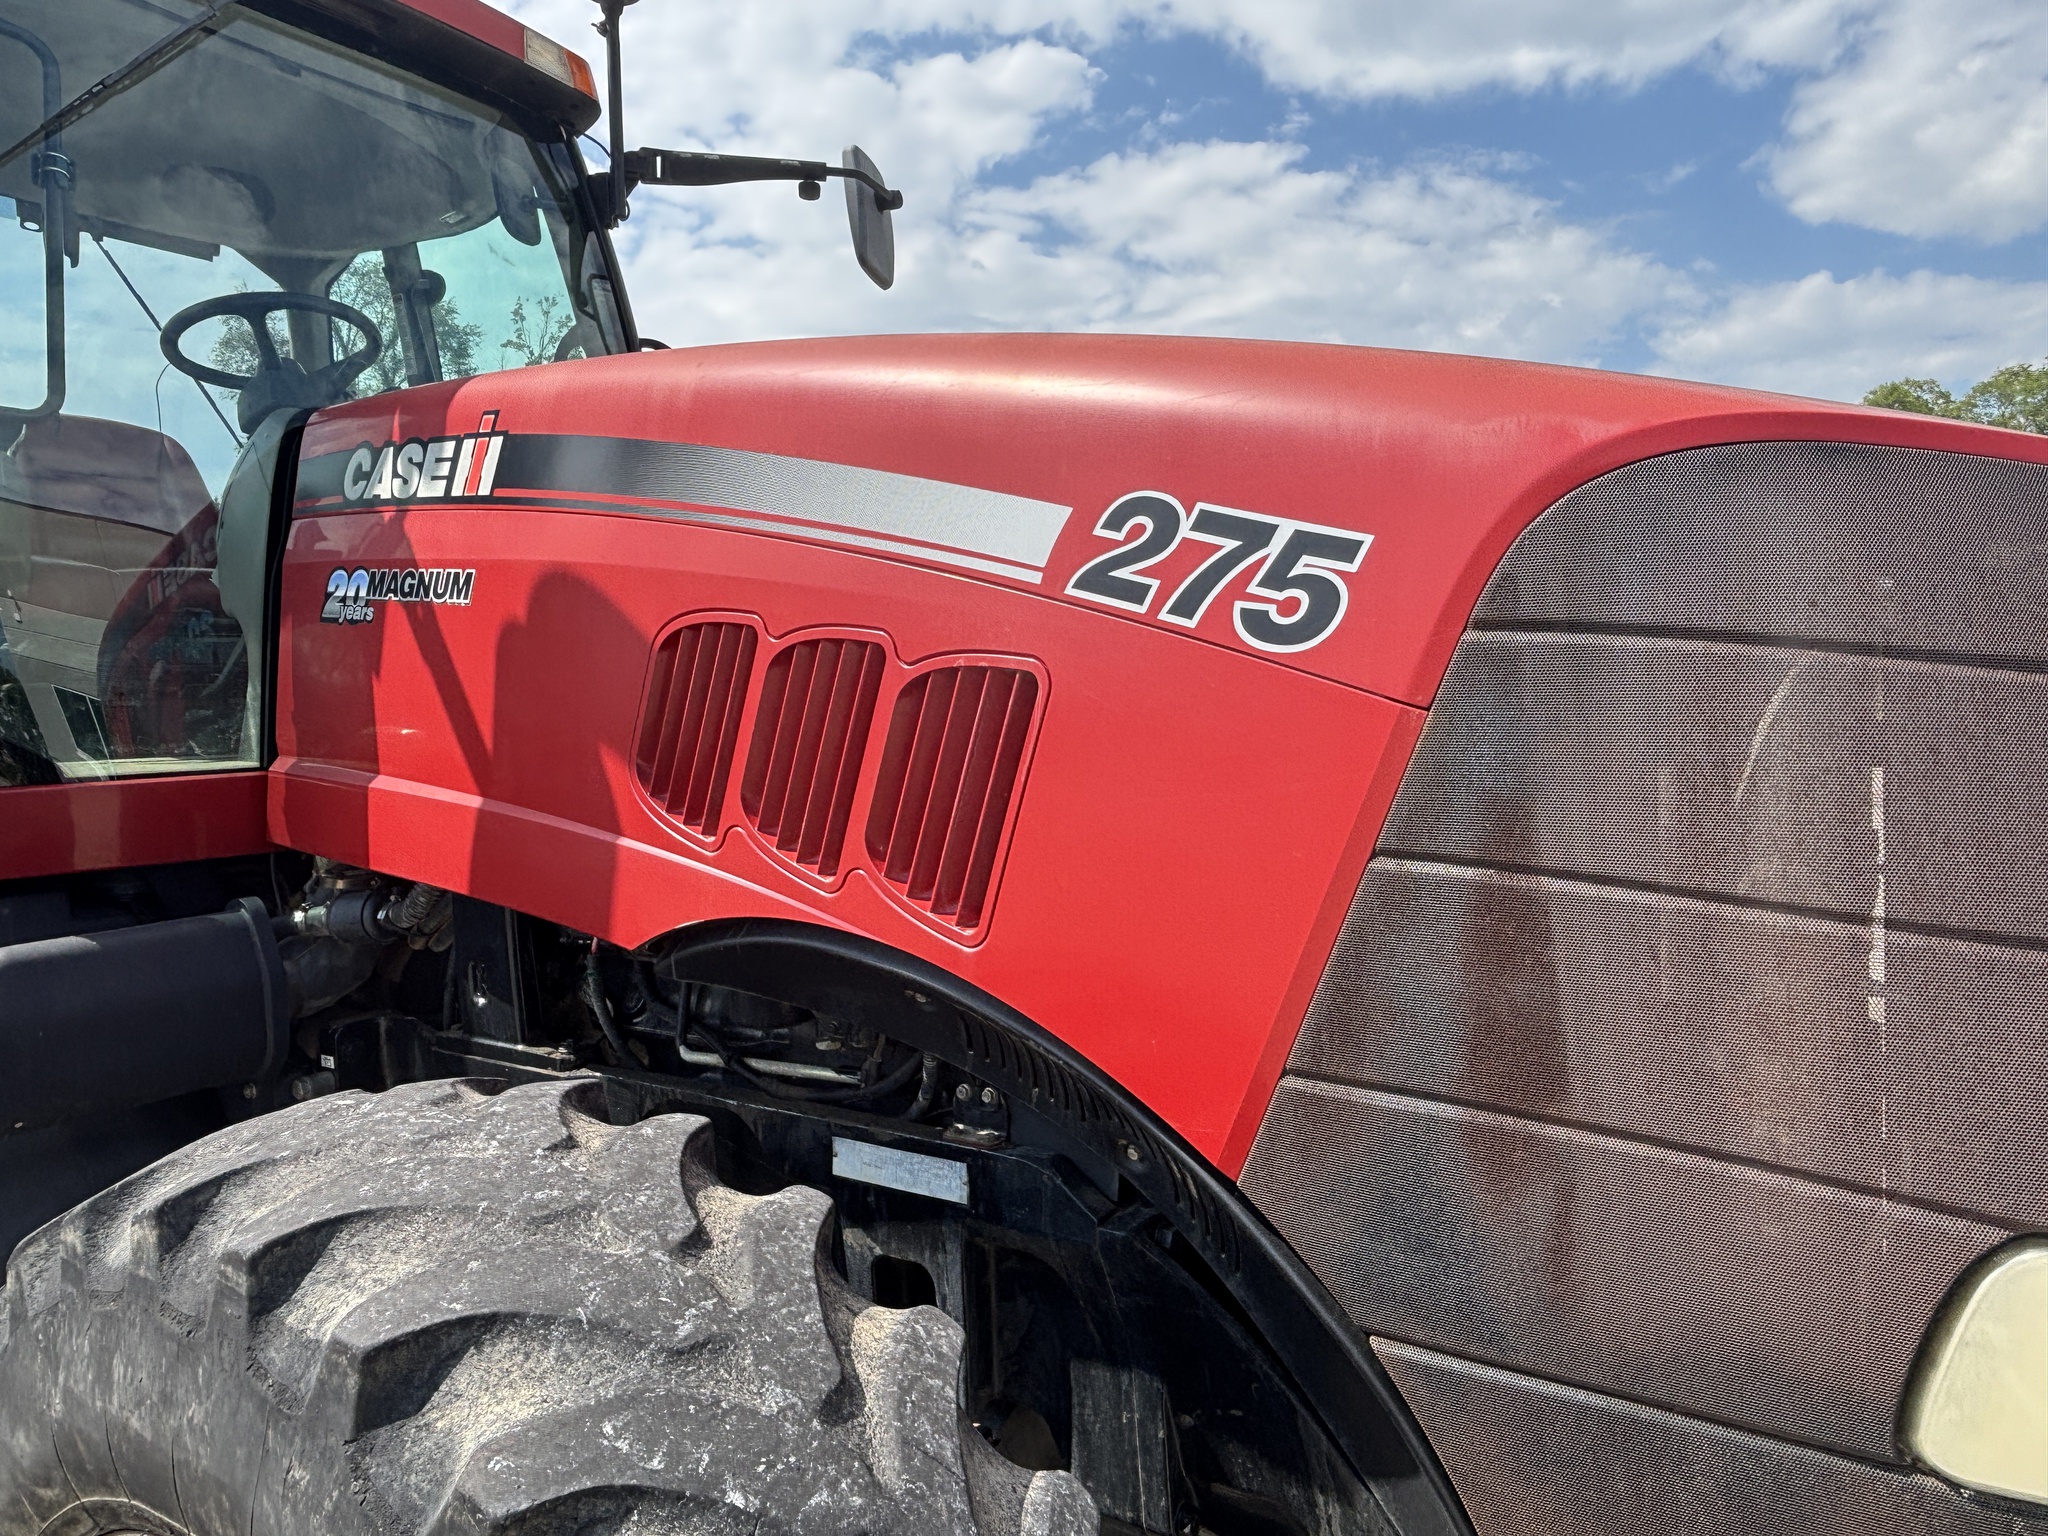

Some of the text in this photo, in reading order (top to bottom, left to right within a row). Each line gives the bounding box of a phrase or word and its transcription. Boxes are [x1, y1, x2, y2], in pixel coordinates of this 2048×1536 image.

[321, 568, 475, 618] 20 MAGNUM
[1064, 490, 1375, 654] 275
[338, 604, 375, 623] years
